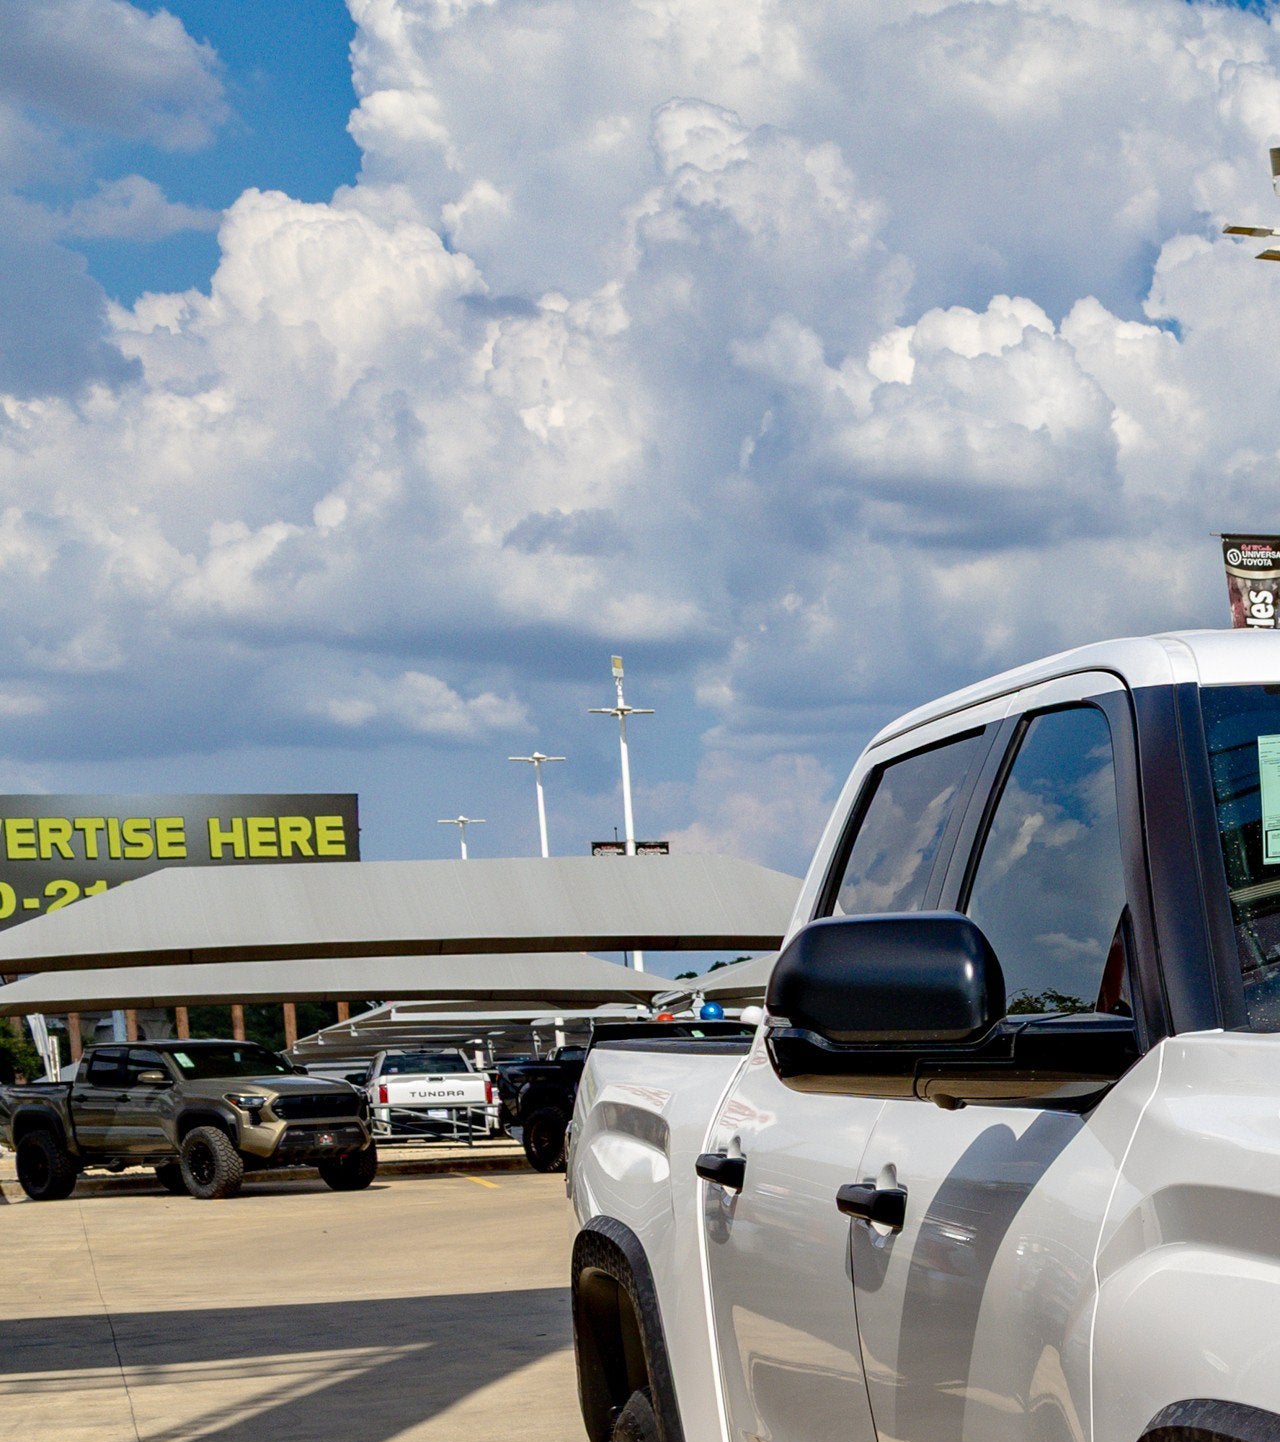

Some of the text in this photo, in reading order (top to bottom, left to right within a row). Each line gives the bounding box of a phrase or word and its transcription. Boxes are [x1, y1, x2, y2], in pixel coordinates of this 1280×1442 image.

[1242, 558, 1273, 567] TOYOTA
[0, 815, 346, 860] ERTISE HERE
[409, 1090, 465, 1098] TUNDRA
